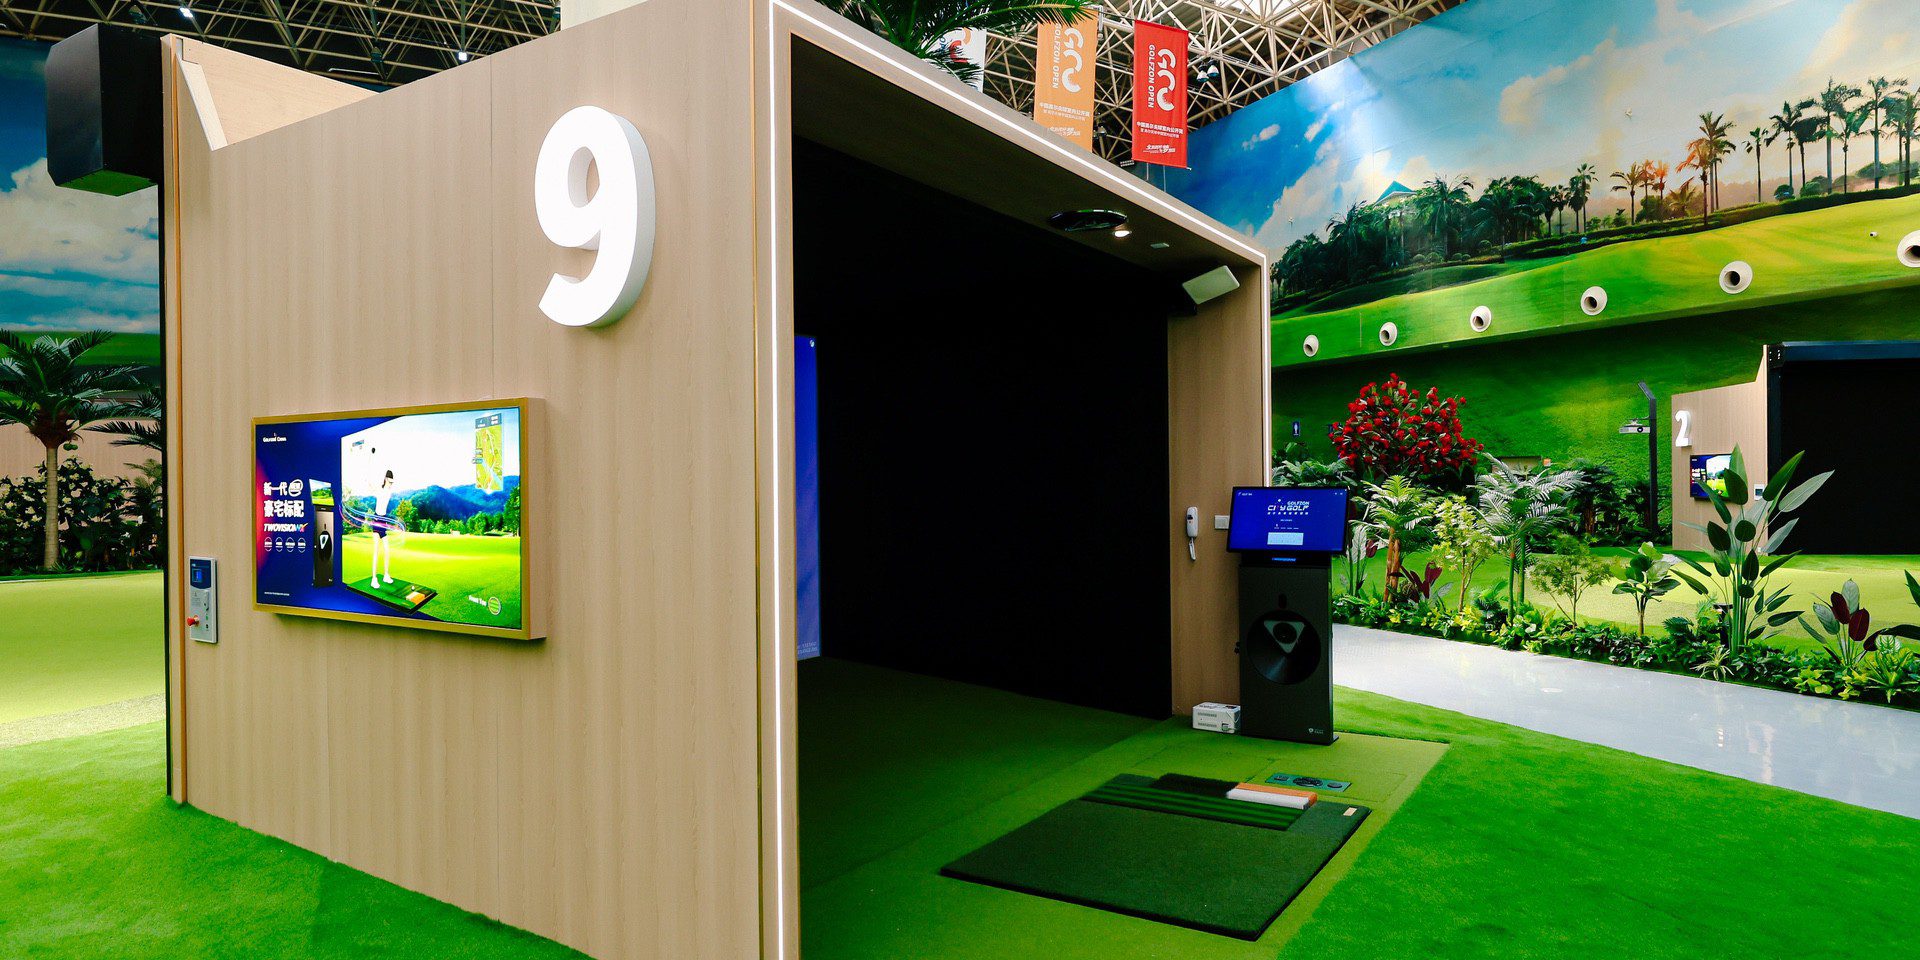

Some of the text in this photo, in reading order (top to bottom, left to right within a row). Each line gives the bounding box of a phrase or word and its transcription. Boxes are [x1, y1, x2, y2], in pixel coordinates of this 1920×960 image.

[1052, 65, 1060, 89] OPEN
[1147, 44, 1156, 109] GOLFZON OPEN
[535, 105, 650, 328] 9
[1675, 410, 1691, 447] 2
[263, 481, 288, 496] 新一代
[264, 500, 304, 518] 豪宅标配
